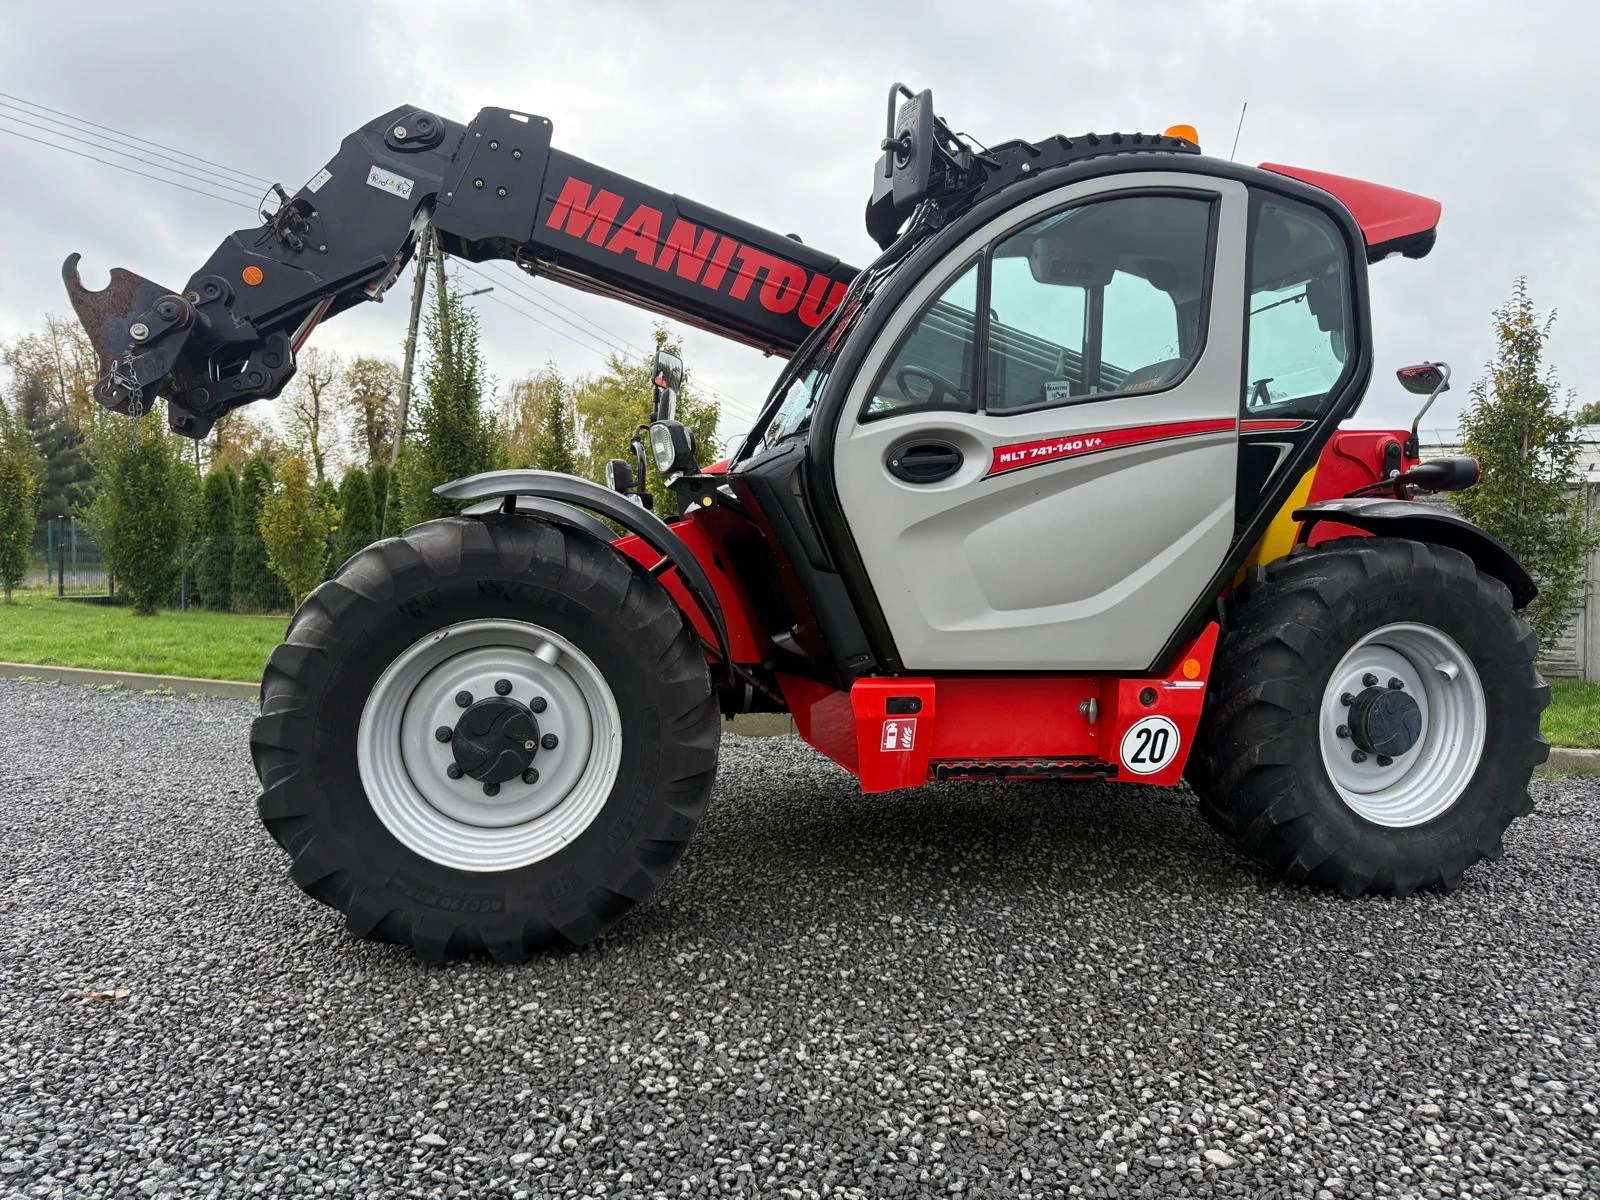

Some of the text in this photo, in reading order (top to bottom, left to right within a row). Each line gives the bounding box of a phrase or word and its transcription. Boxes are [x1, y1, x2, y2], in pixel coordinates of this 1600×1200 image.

[545, 176, 851, 328] MANITOU
[1000, 437, 1102, 462] MLT 741-140 V+
[1131, 727, 1169, 763] 20
